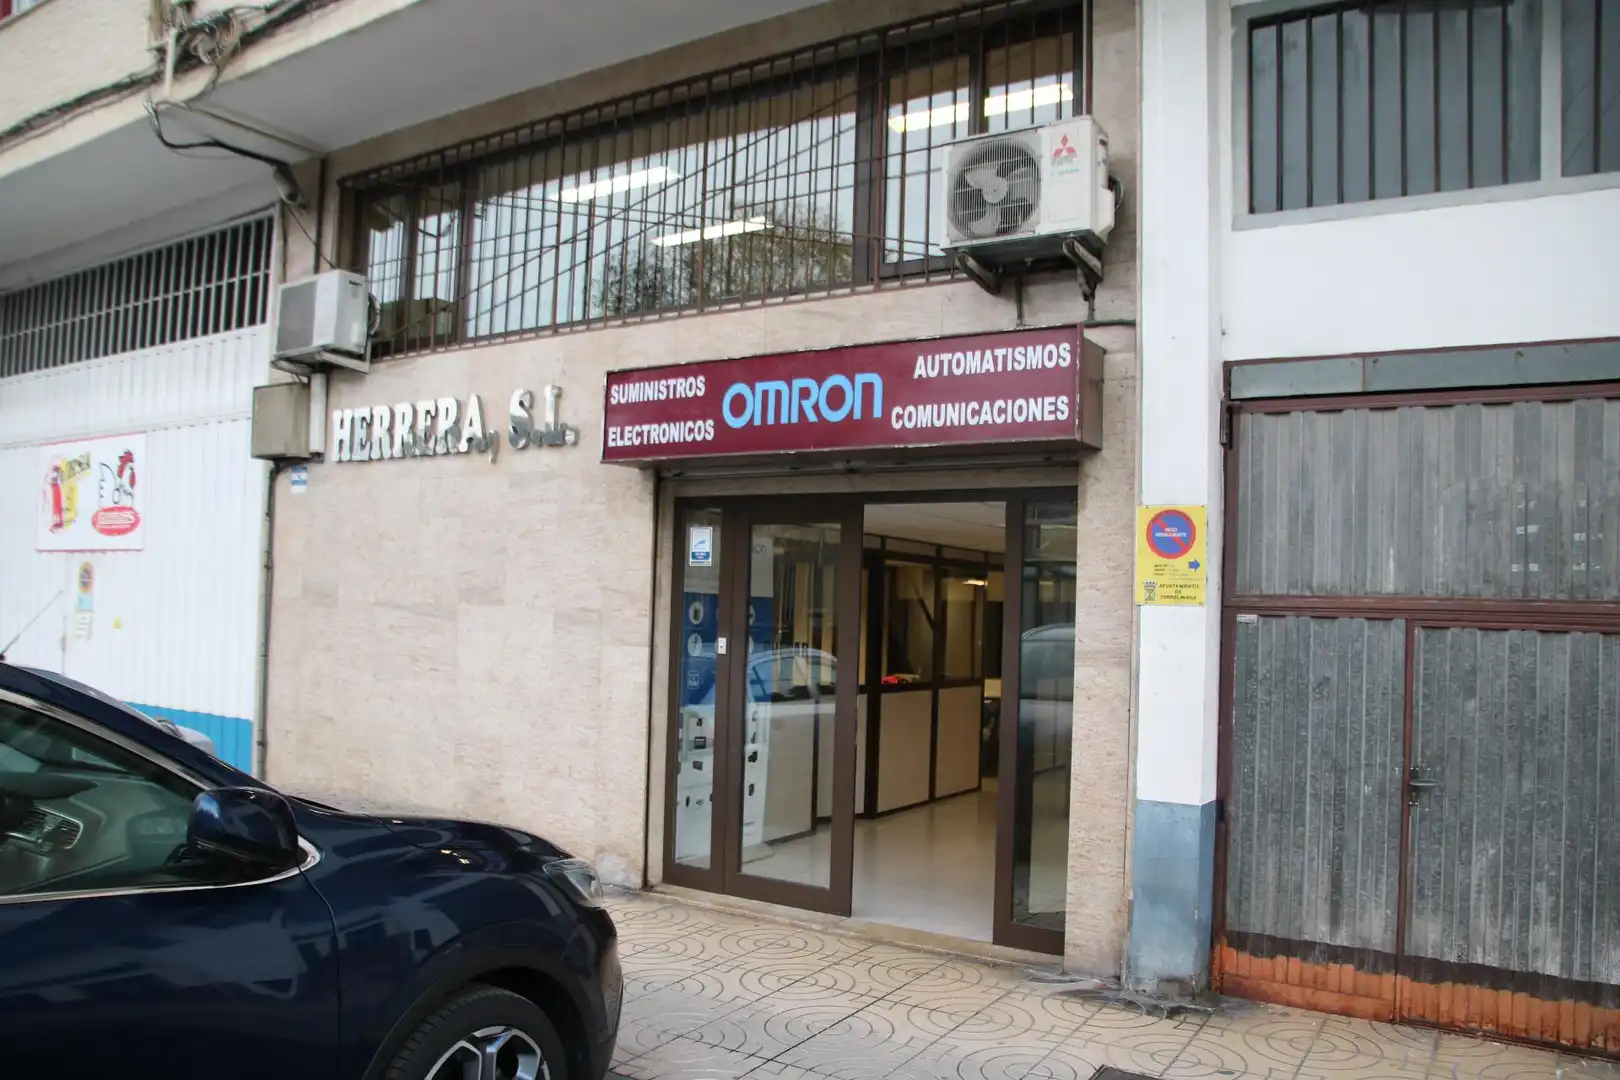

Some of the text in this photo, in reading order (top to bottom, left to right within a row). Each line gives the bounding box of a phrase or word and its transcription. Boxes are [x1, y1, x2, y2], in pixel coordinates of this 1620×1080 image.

[913, 342, 1071, 379] AUTOMATISMOS
[610, 375, 706, 405] SUMINISTROS
[722, 372, 883, 429] OMRON
[331, 384, 580, 464] HERRERA, S.L.
[891, 395, 1070, 430] COMUNICACIONES
[608, 419, 715, 447] ELECTRONICOS
